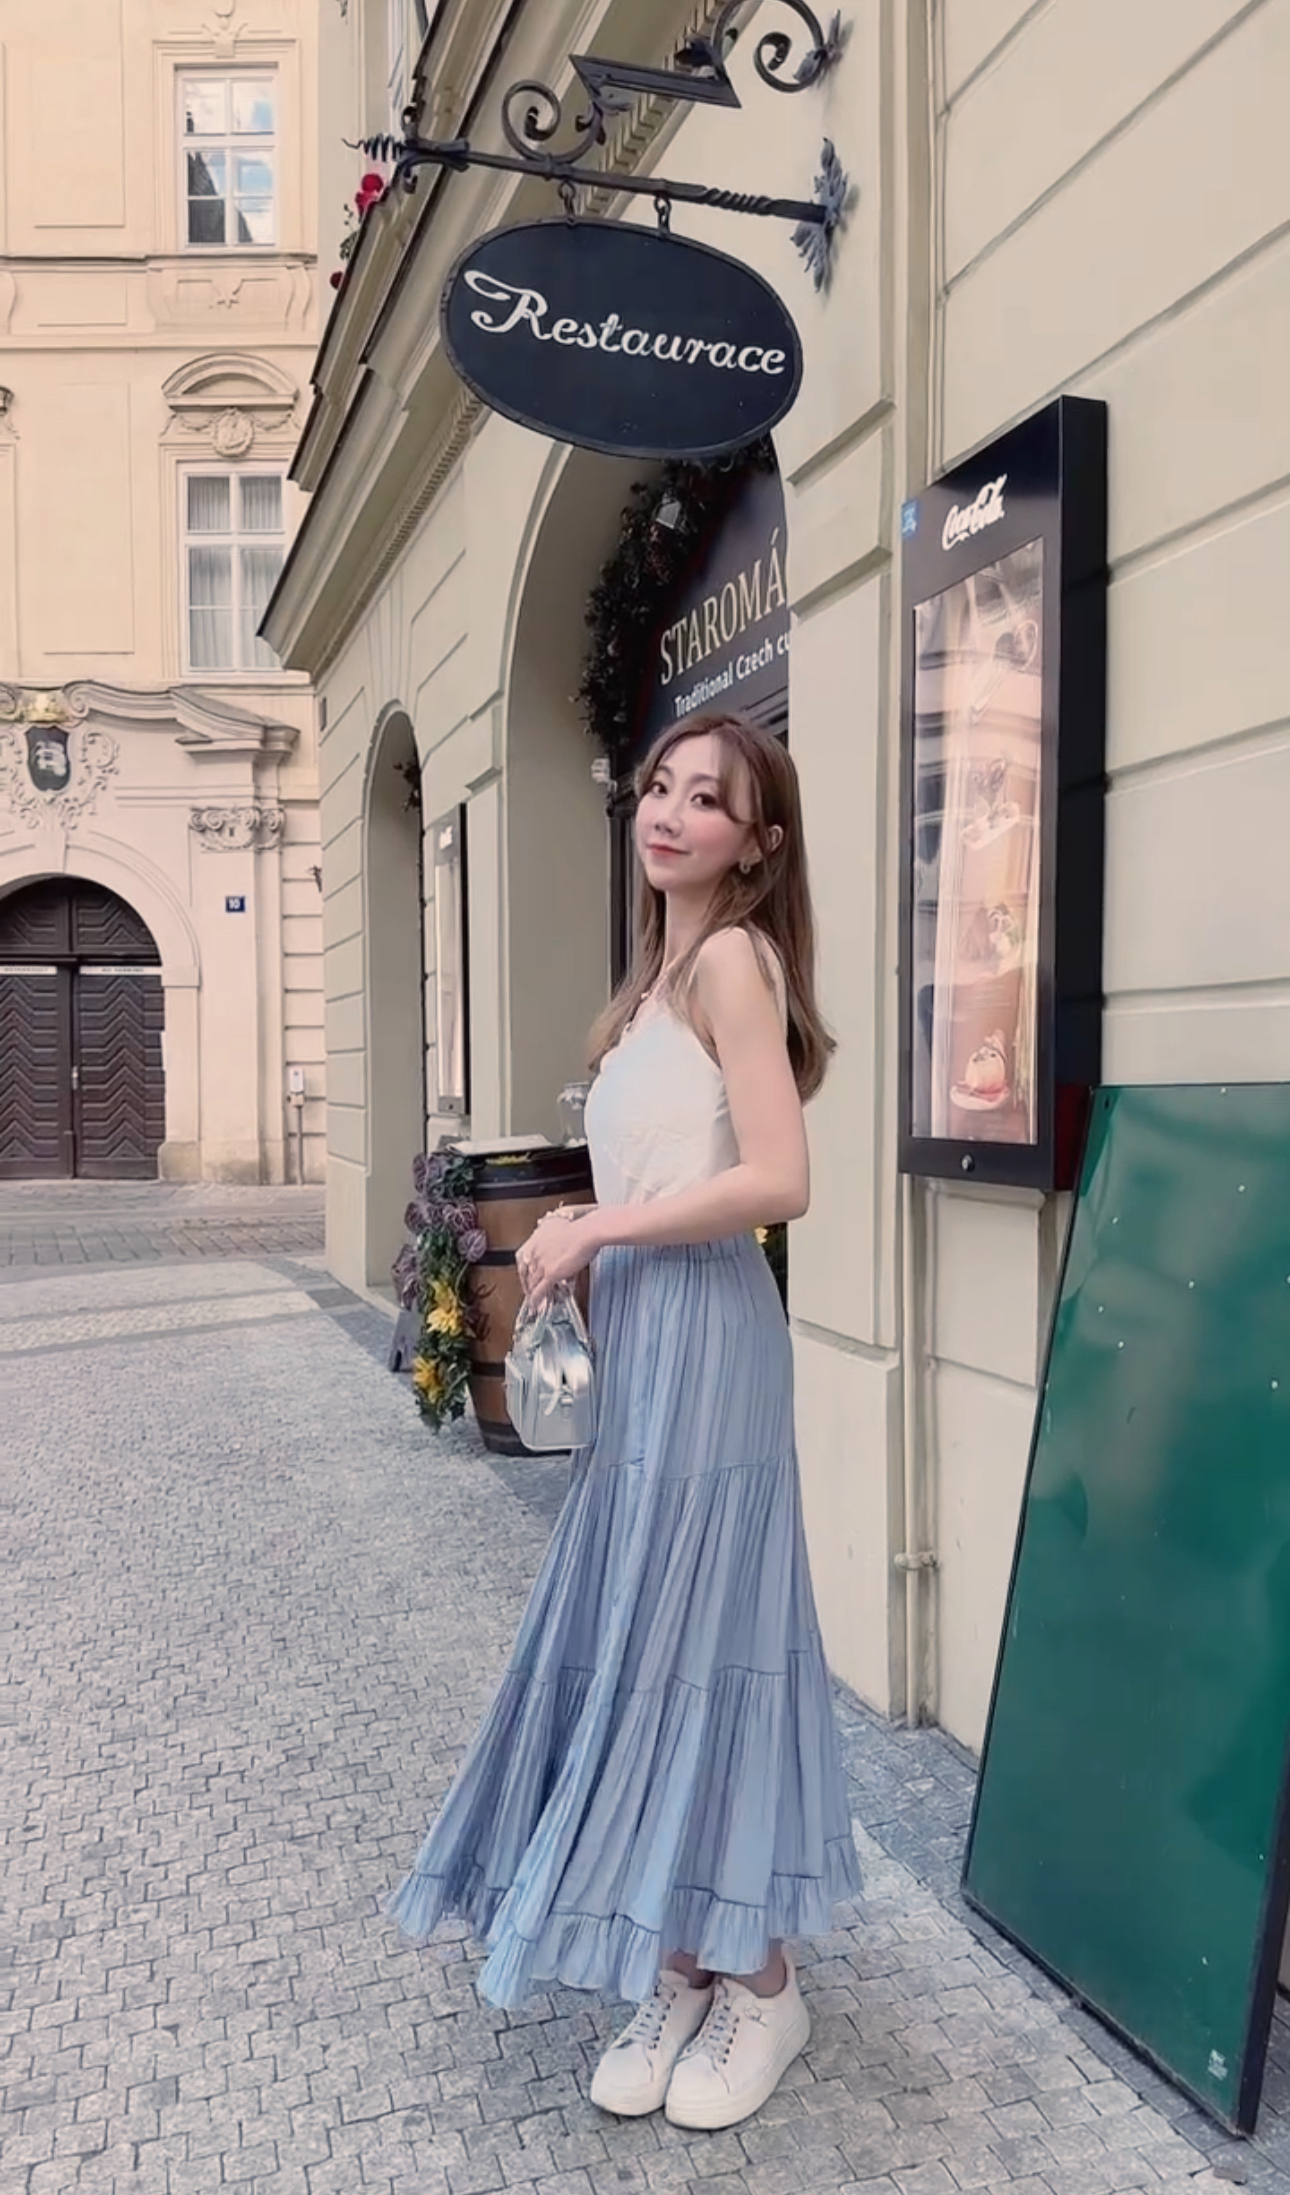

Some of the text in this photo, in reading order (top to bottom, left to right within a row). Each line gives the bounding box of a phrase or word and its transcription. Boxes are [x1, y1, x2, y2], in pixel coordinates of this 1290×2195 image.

[464, 269, 786, 375] Restaurace
[675, 661, 734, 718] Traditional
[736, 638, 774, 680] Czech
